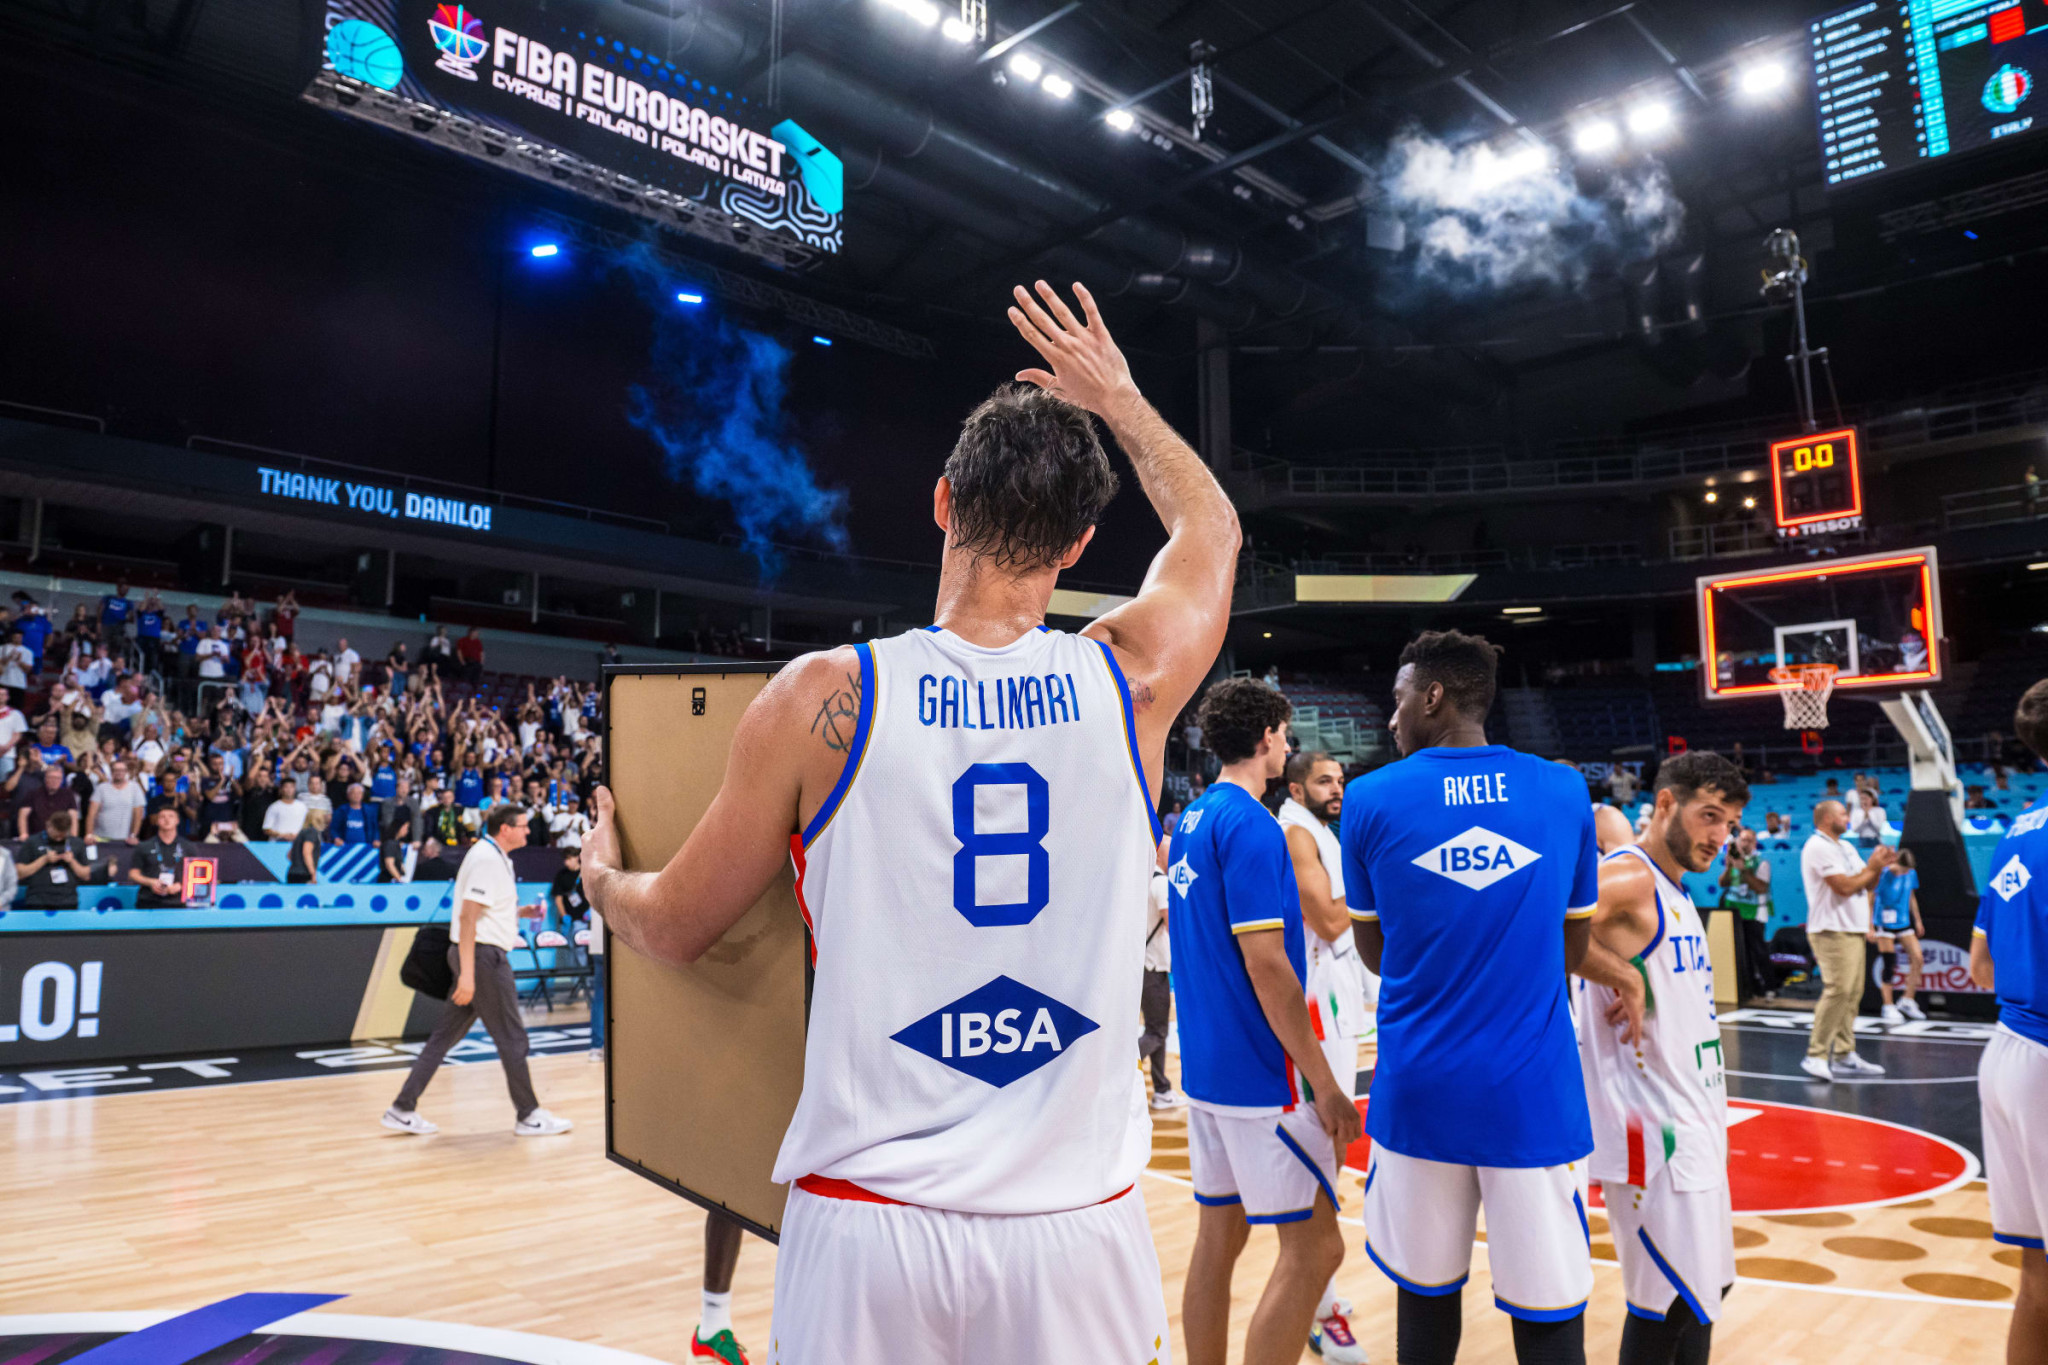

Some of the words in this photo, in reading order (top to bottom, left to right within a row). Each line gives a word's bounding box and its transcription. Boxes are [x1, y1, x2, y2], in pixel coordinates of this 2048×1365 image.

[492, 27, 578, 97] FIBA
[582, 62, 787, 178] EUROBASKET
[492, 70, 562, 112] CYPRUS
[575, 102, 649, 144] FINLAND
[661, 135, 721, 173] POLAND
[732, 163, 787, 198] LATVIA
[1793, 443, 1834, 471] 0.0
[257, 466, 341, 505] THANK
[344, 482, 399, 518] YOU,
[405, 492, 491, 531] DANILO!
[1799, 515, 1862, 536] TISSOT
[919, 673, 1080, 730] GALLINARI
[1443, 772, 1509, 806] AKELE
[952, 762, 1049, 927] 8
[1440, 844, 1515, 873] IBSA
[0, 961, 103, 1042] O!
[942, 1008, 1062, 1058] IBSA
